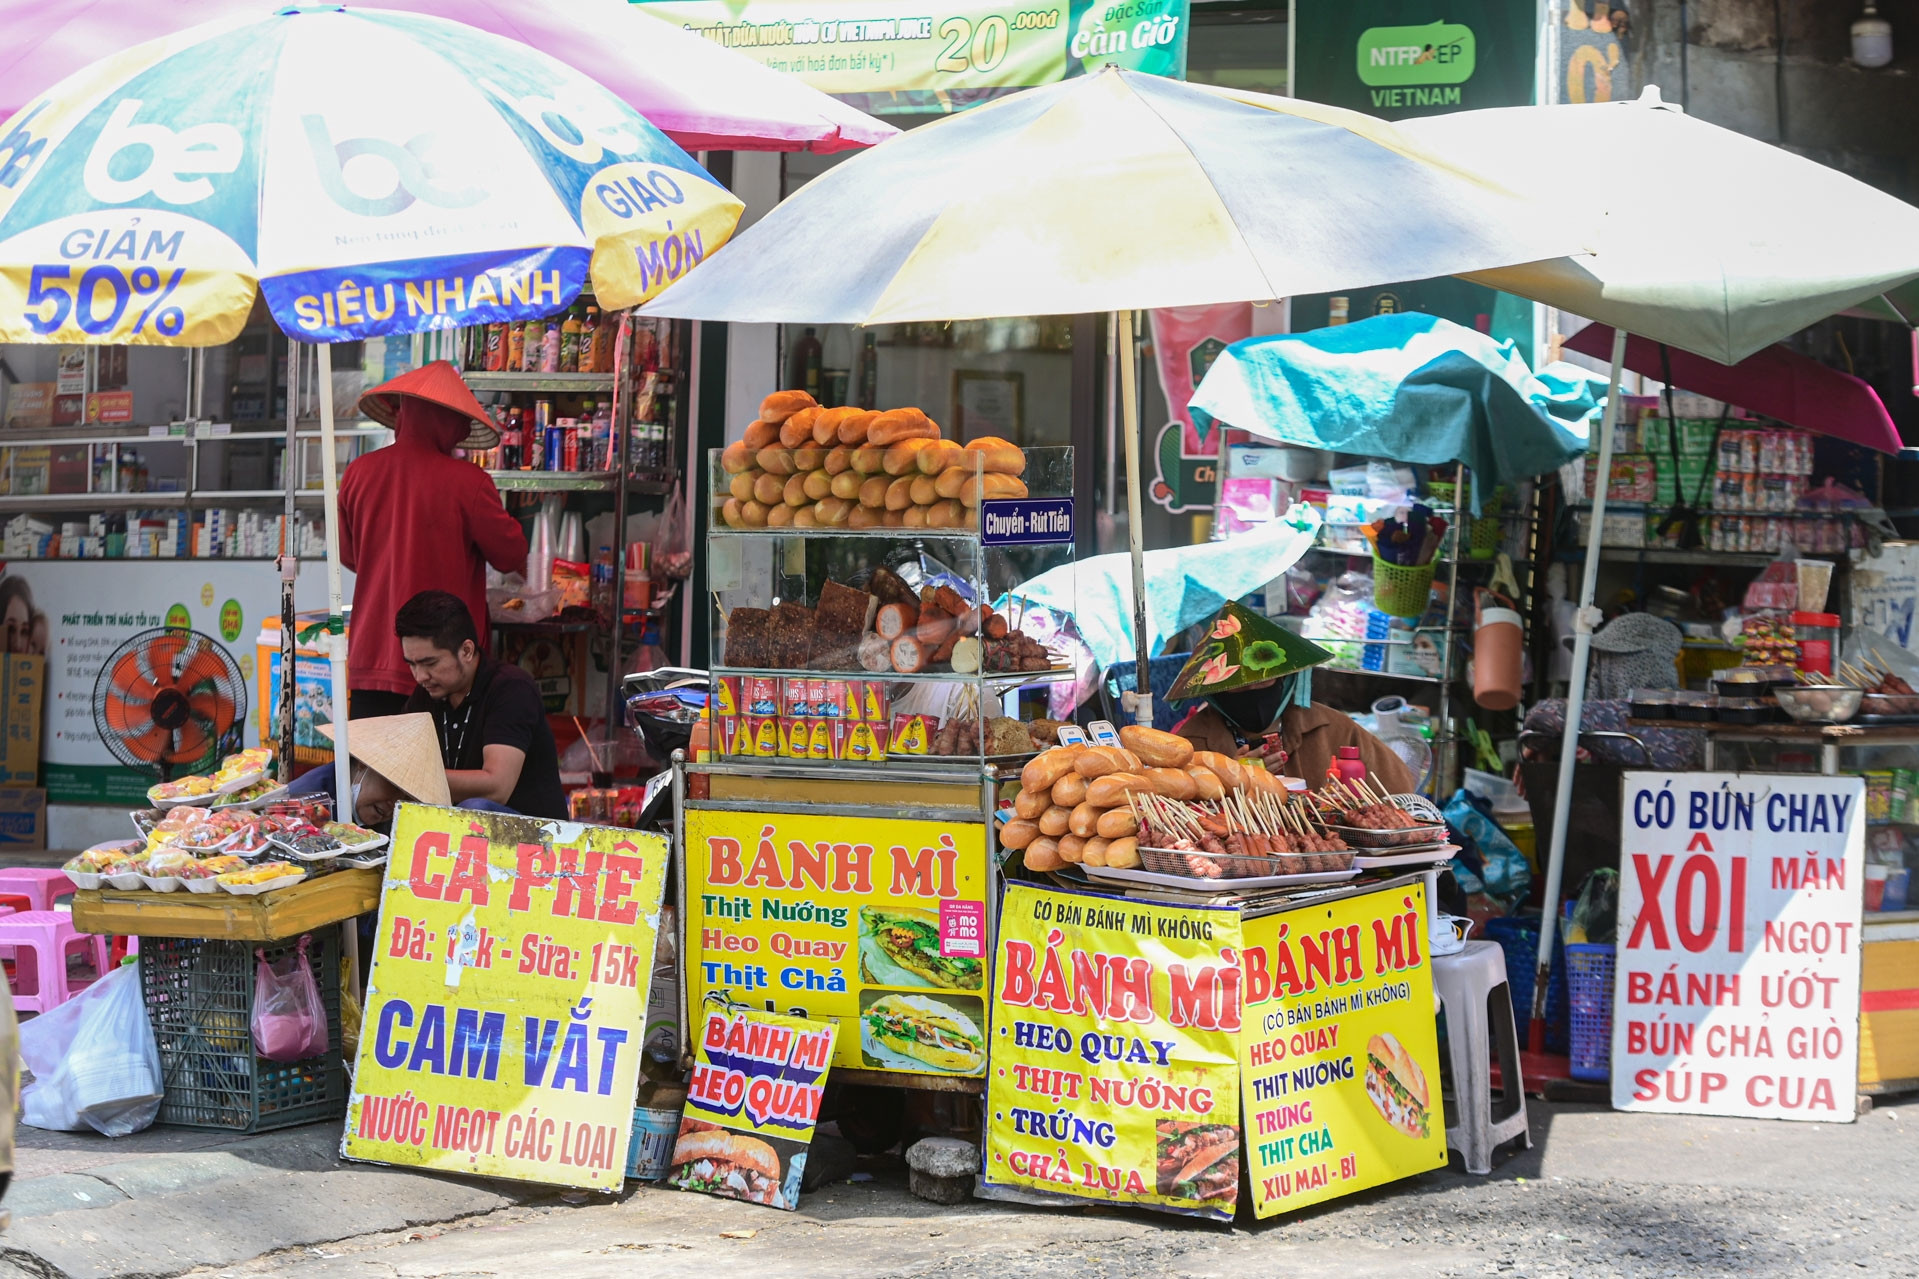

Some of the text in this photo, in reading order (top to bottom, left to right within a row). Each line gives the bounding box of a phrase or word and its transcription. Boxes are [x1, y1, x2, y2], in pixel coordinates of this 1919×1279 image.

[1070, 14, 1179, 59] Cần Giờ
[1105, 4, 1133, 23] Đặc
[1370, 87, 1461, 107] VIETNAM
[84, 99, 244, 204] be
[595, 170, 685, 219] GIAO
[59, 217, 185, 261] GIẢM
[634, 220, 704, 293] MÓN
[24, 264, 187, 337] 50%
[294, 267, 562, 330] SIÊU NHANH
[985, 507, 1024, 537] Chuyển
[1030, 511, 1048, 533] Rút
[1048, 507, 1070, 532] Tiền
[1633, 780, 1852, 833] CÓ BÚN CHAY
[409, 821, 643, 926] CÀ PHÊ
[707, 825, 959, 898] BÁNH MÌ
[701, 894, 848, 928] Thịt Nướng
[1626, 832, 1846, 953] XÔI MẶN
[1034, 897, 1213, 941] CÓ BÁN BÁNH MÌ KHÔNG
[1765, 921, 1853, 963] NGỌT
[389, 915, 436, 962] Đá:
[518, 933, 581, 980] Sữa:
[702, 928, 848, 962] Heo Quay
[1242, 896, 1422, 1006] BÁNH MÌ
[701, 961, 847, 992] Thịt Chả
[1001, 928, 1241, 1033] BÁNH MÌ
[1628, 963, 1840, 1009] BÁNH ƯỚT
[1287, 1003, 1312, 1026] BÁN
[1316, 996, 1347, 1021] BÁNH
[1350, 990, 1364, 1011] MÌ
[1366, 982, 1411, 1008] KHÔNG)
[373, 996, 628, 1096] CAM VẮT
[705, 1015, 831, 1068] BÁNH MÌ
[1014, 1021, 1176, 1066] HEO QUAY
[1250, 1024, 1339, 1067] HEO QUAY
[1628, 1012, 1843, 1060] BÚN CHẢ GIÒ
[688, 1065, 824, 1121] HEO QUAY
[1013, 1064, 1214, 1114] THỊT NƯỚNG
[1252, 1072, 1289, 1102] THỊT
[1633, 1062, 1837, 1111] SÚP CUA
[358, 1089, 618, 1179] NƯỚC NGỌT CÁC LOẠI
[1010, 1108, 1116, 1148] TRỨNG
[1258, 1122, 1333, 1168] THỊT CHẢ
[1009, 1148, 1149, 1197] CHẢ LỤA
[1295, 1161, 1328, 1193] MẠI
